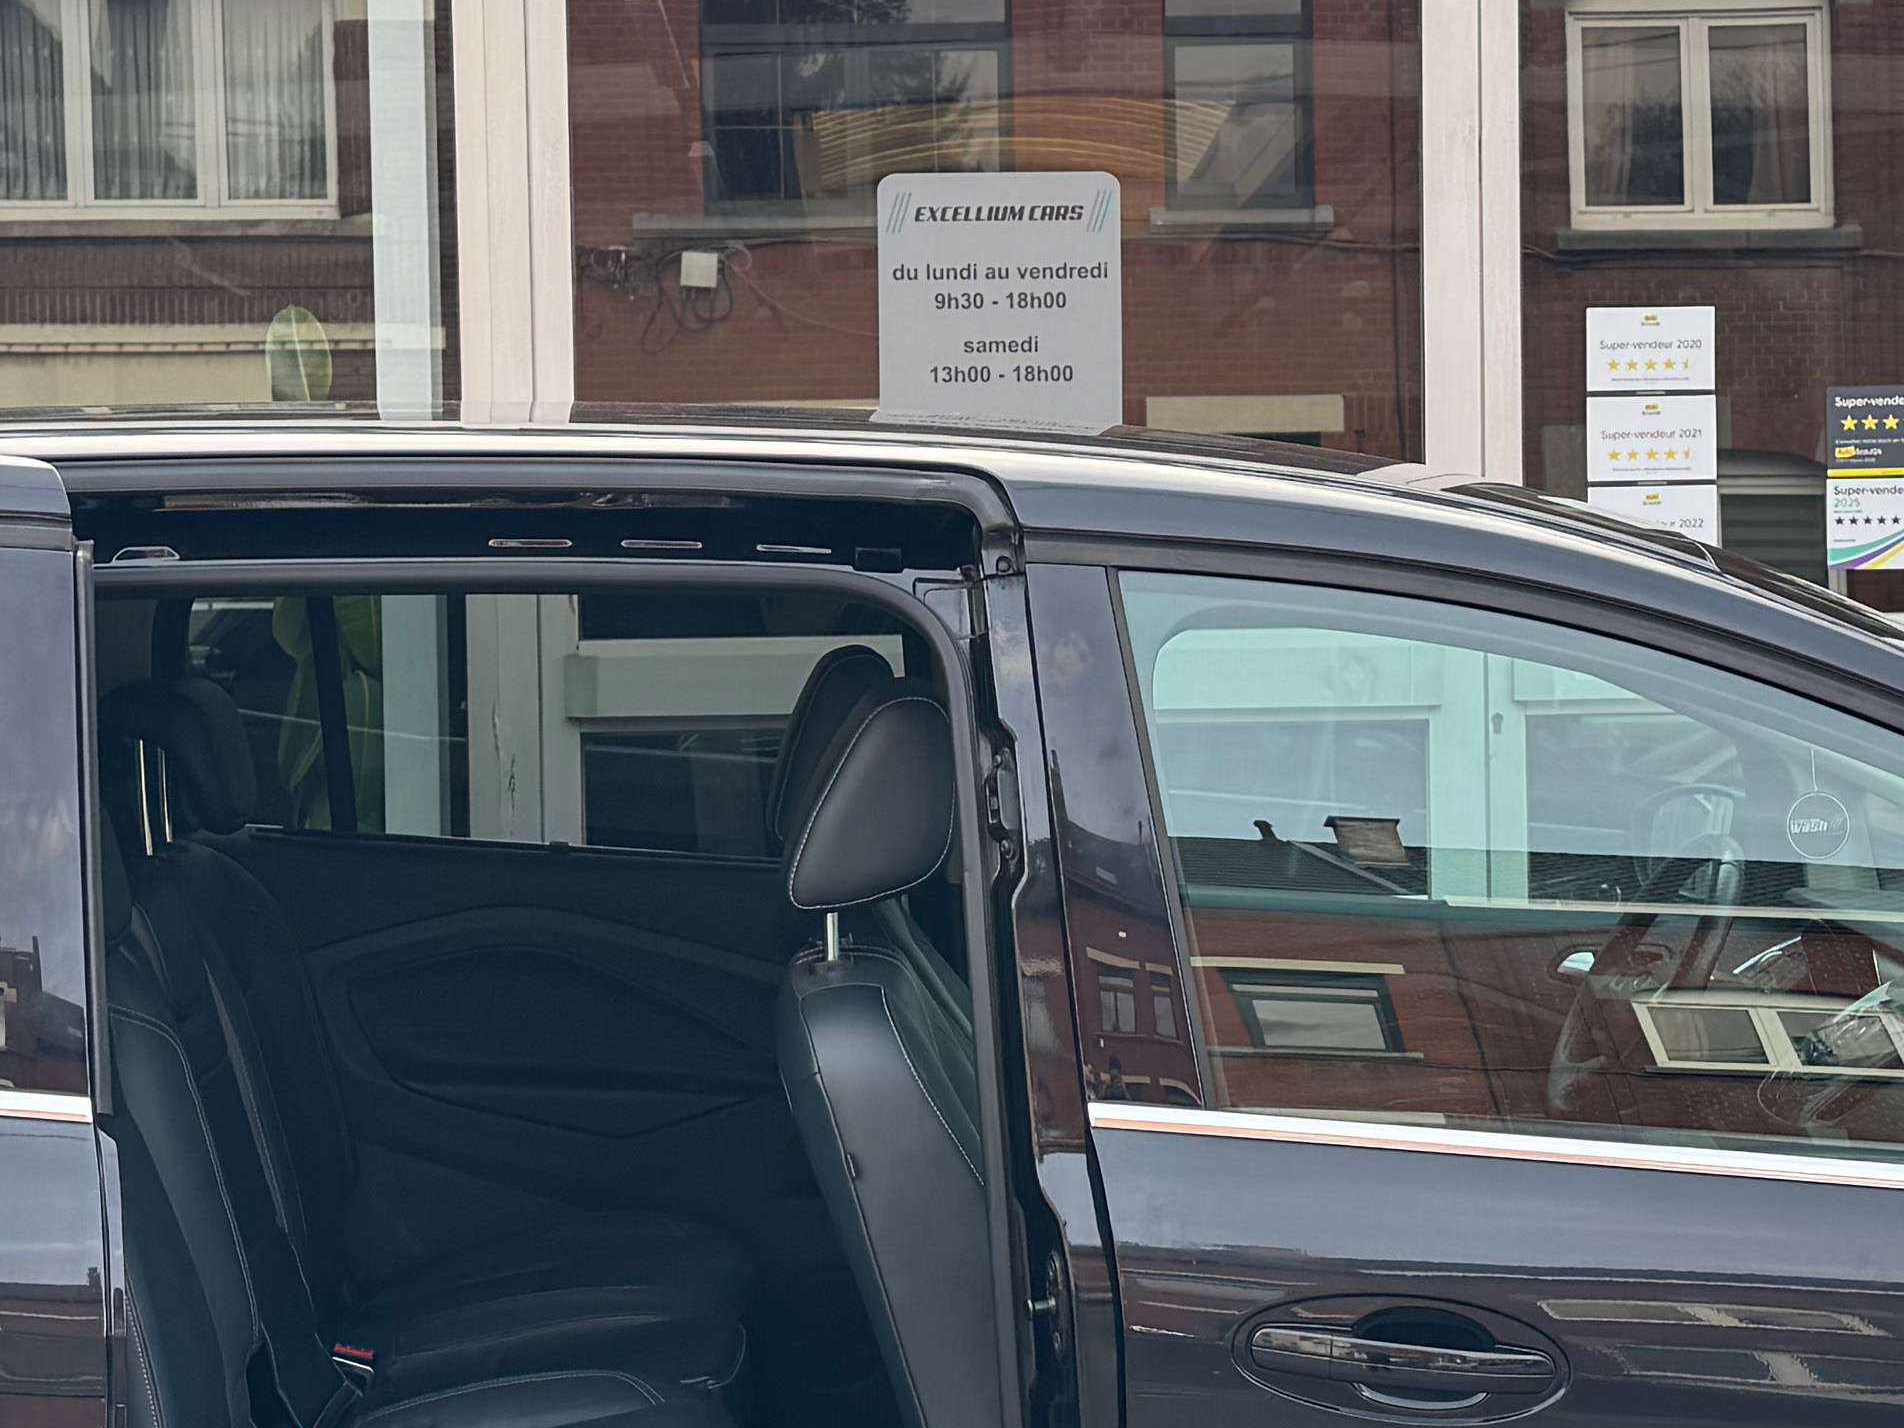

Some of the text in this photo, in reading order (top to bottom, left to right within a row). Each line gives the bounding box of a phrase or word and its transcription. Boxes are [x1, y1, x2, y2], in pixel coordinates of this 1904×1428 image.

[913, 204, 1084, 222] EXCELLIUM CARS
[892, 262, 1109, 281] du lundi au vendredi
[934, 292, 984, 310] 9h30
[1005, 291, 1067, 309] 18h00
[963, 336, 1039, 354] samedi
[1600, 339, 1702, 351] Super-vendeur 2020
[930, 366, 991, 383] 13h00
[1012, 365, 1074, 383] 18h00
[1601, 429, 1702, 441] Super-vendeur 2021
[1834, 498, 1861, 508] 2025
[1679, 518, 1704, 529] 2022
